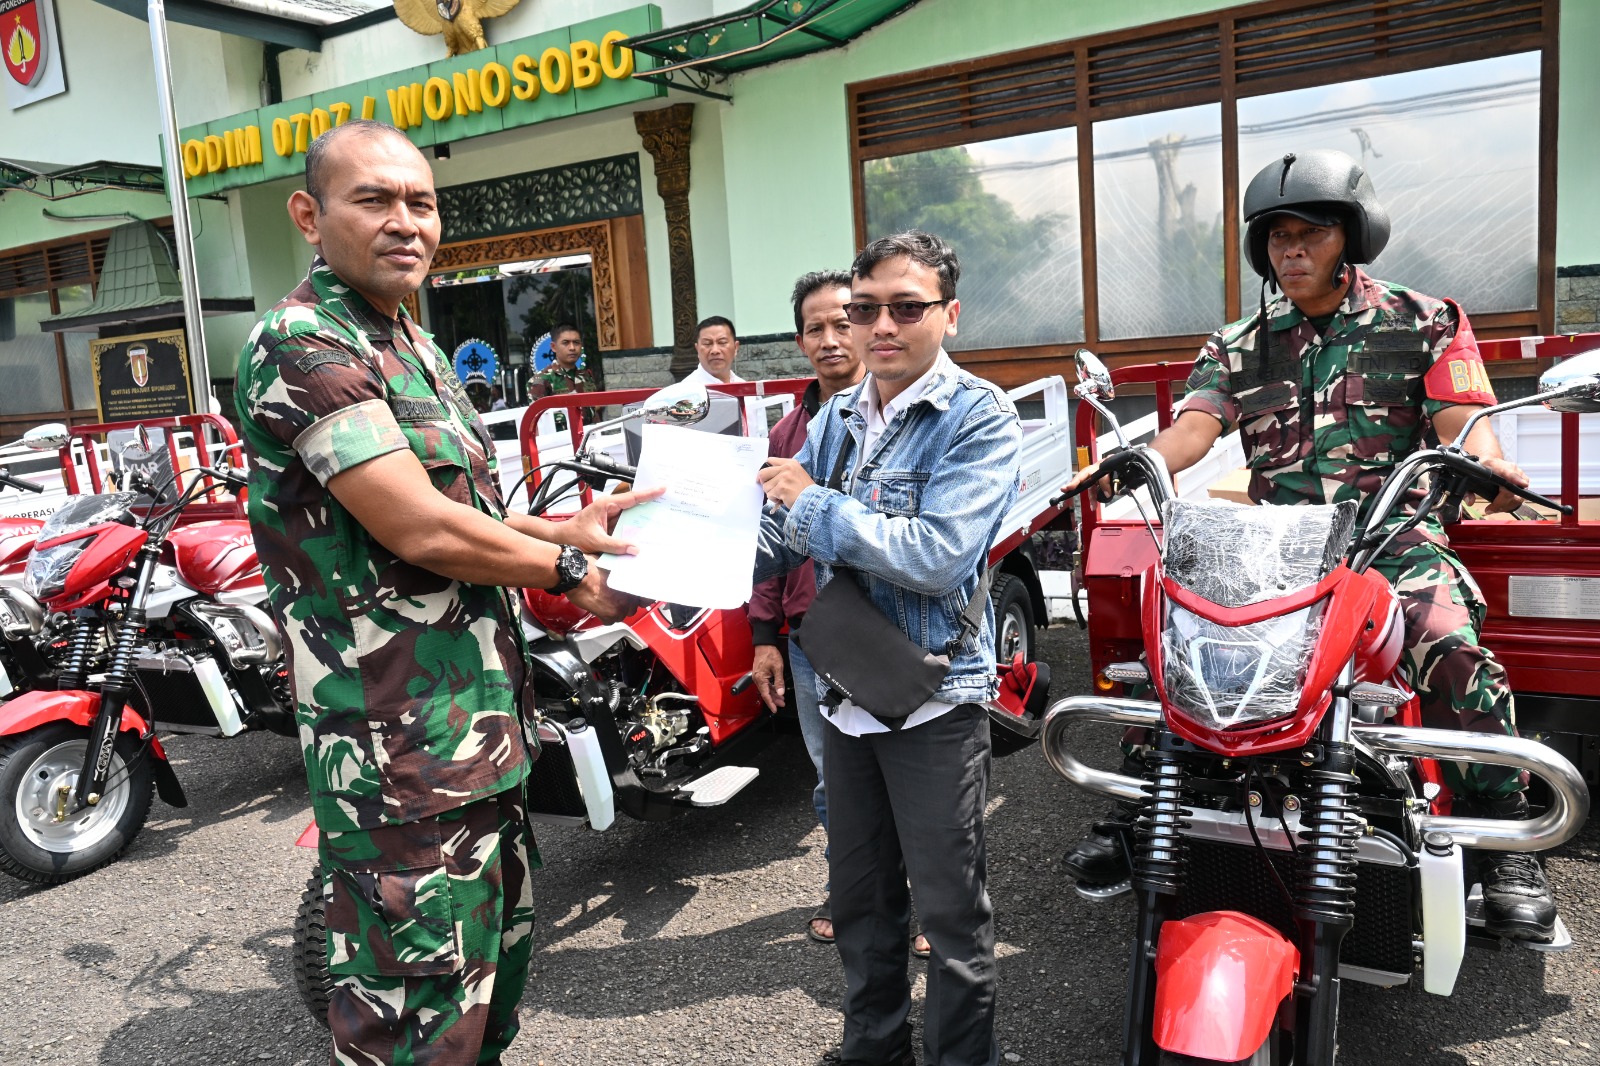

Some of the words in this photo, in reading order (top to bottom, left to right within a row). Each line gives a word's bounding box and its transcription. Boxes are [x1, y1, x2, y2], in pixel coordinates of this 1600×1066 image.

[387, 30, 633, 130] WONOSOBO
[1358, 354, 1387, 370] TNI
[1395, 356, 1422, 370] AD
[124, 461, 160, 476] VIAR
[631, 730, 647, 742] VIAR
